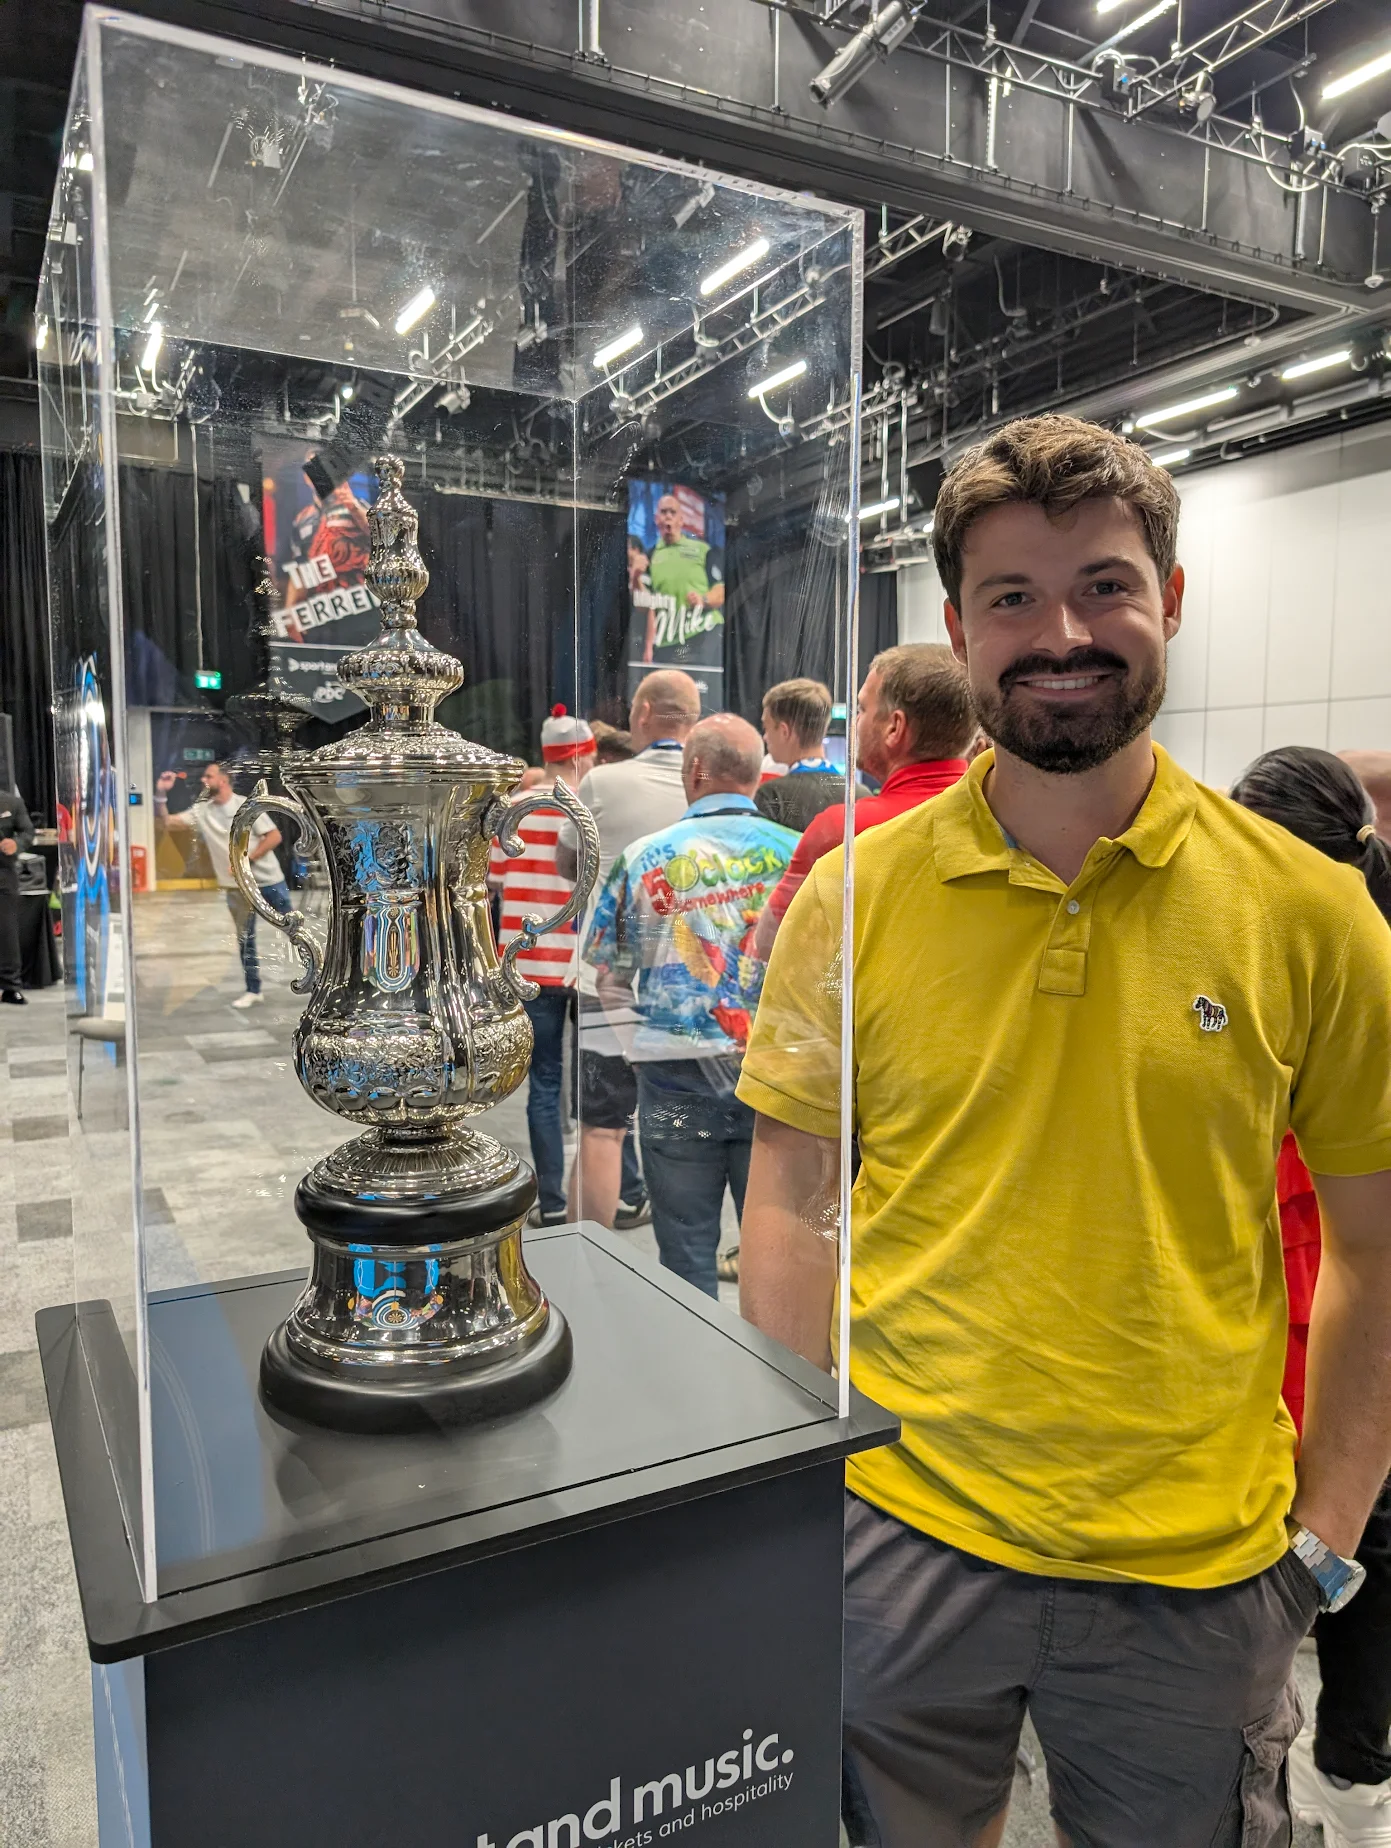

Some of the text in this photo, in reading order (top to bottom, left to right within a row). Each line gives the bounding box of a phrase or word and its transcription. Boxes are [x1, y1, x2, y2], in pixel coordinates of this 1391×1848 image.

[282, 555, 336, 589] THE
[654, 603, 715, 647] Mike
[633, 1728, 794, 1824] music.
[659, 1808, 695, 1837] and
[701, 1772, 794, 1821] hospitality
